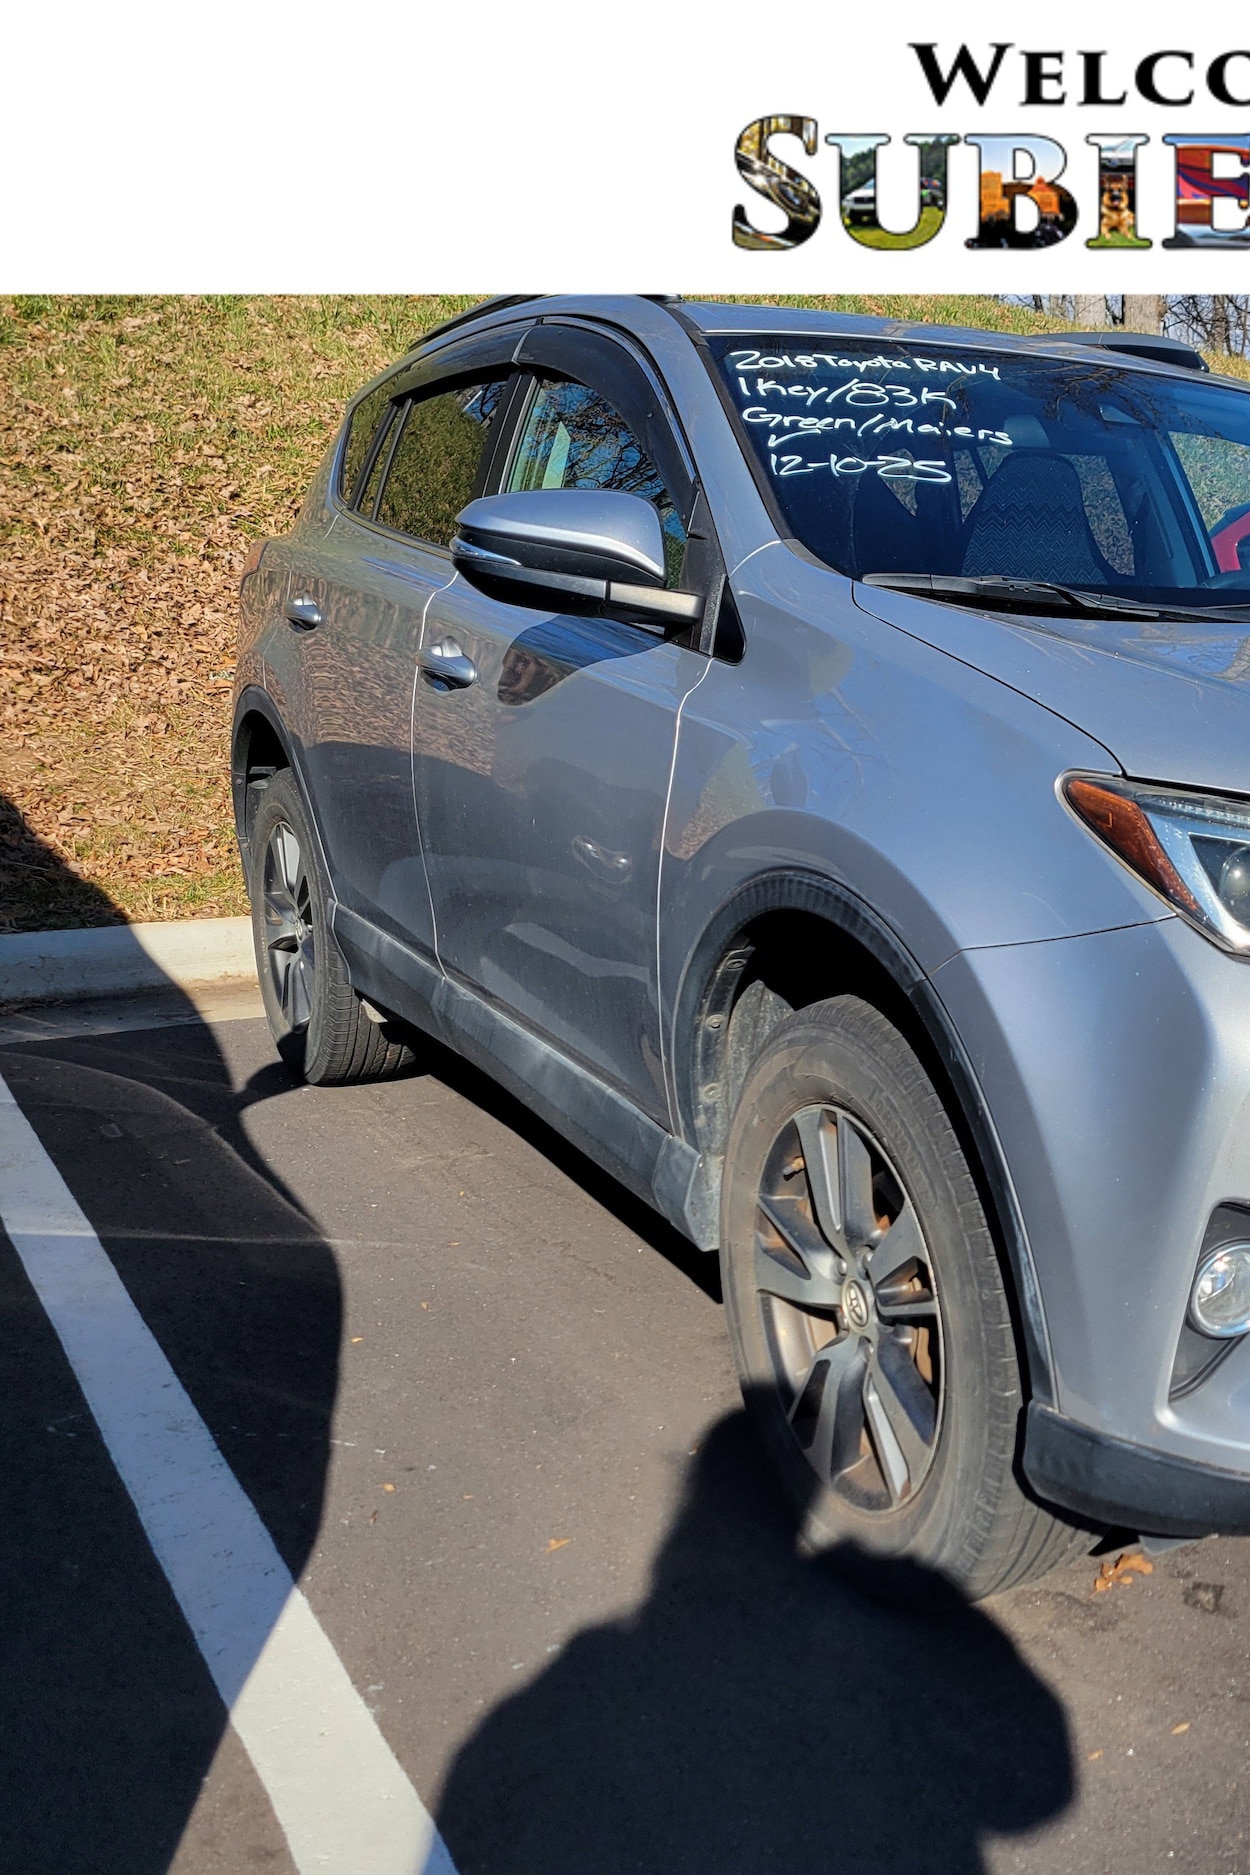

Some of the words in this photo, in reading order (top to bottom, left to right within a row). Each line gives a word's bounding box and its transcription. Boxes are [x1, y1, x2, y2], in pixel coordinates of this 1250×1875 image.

[729, 350, 817, 370] 2018
[812, 353, 912, 373] Toyota
[911, 357, 1002, 381] RAV4
[770, 453, 952, 483] 12-10-25
